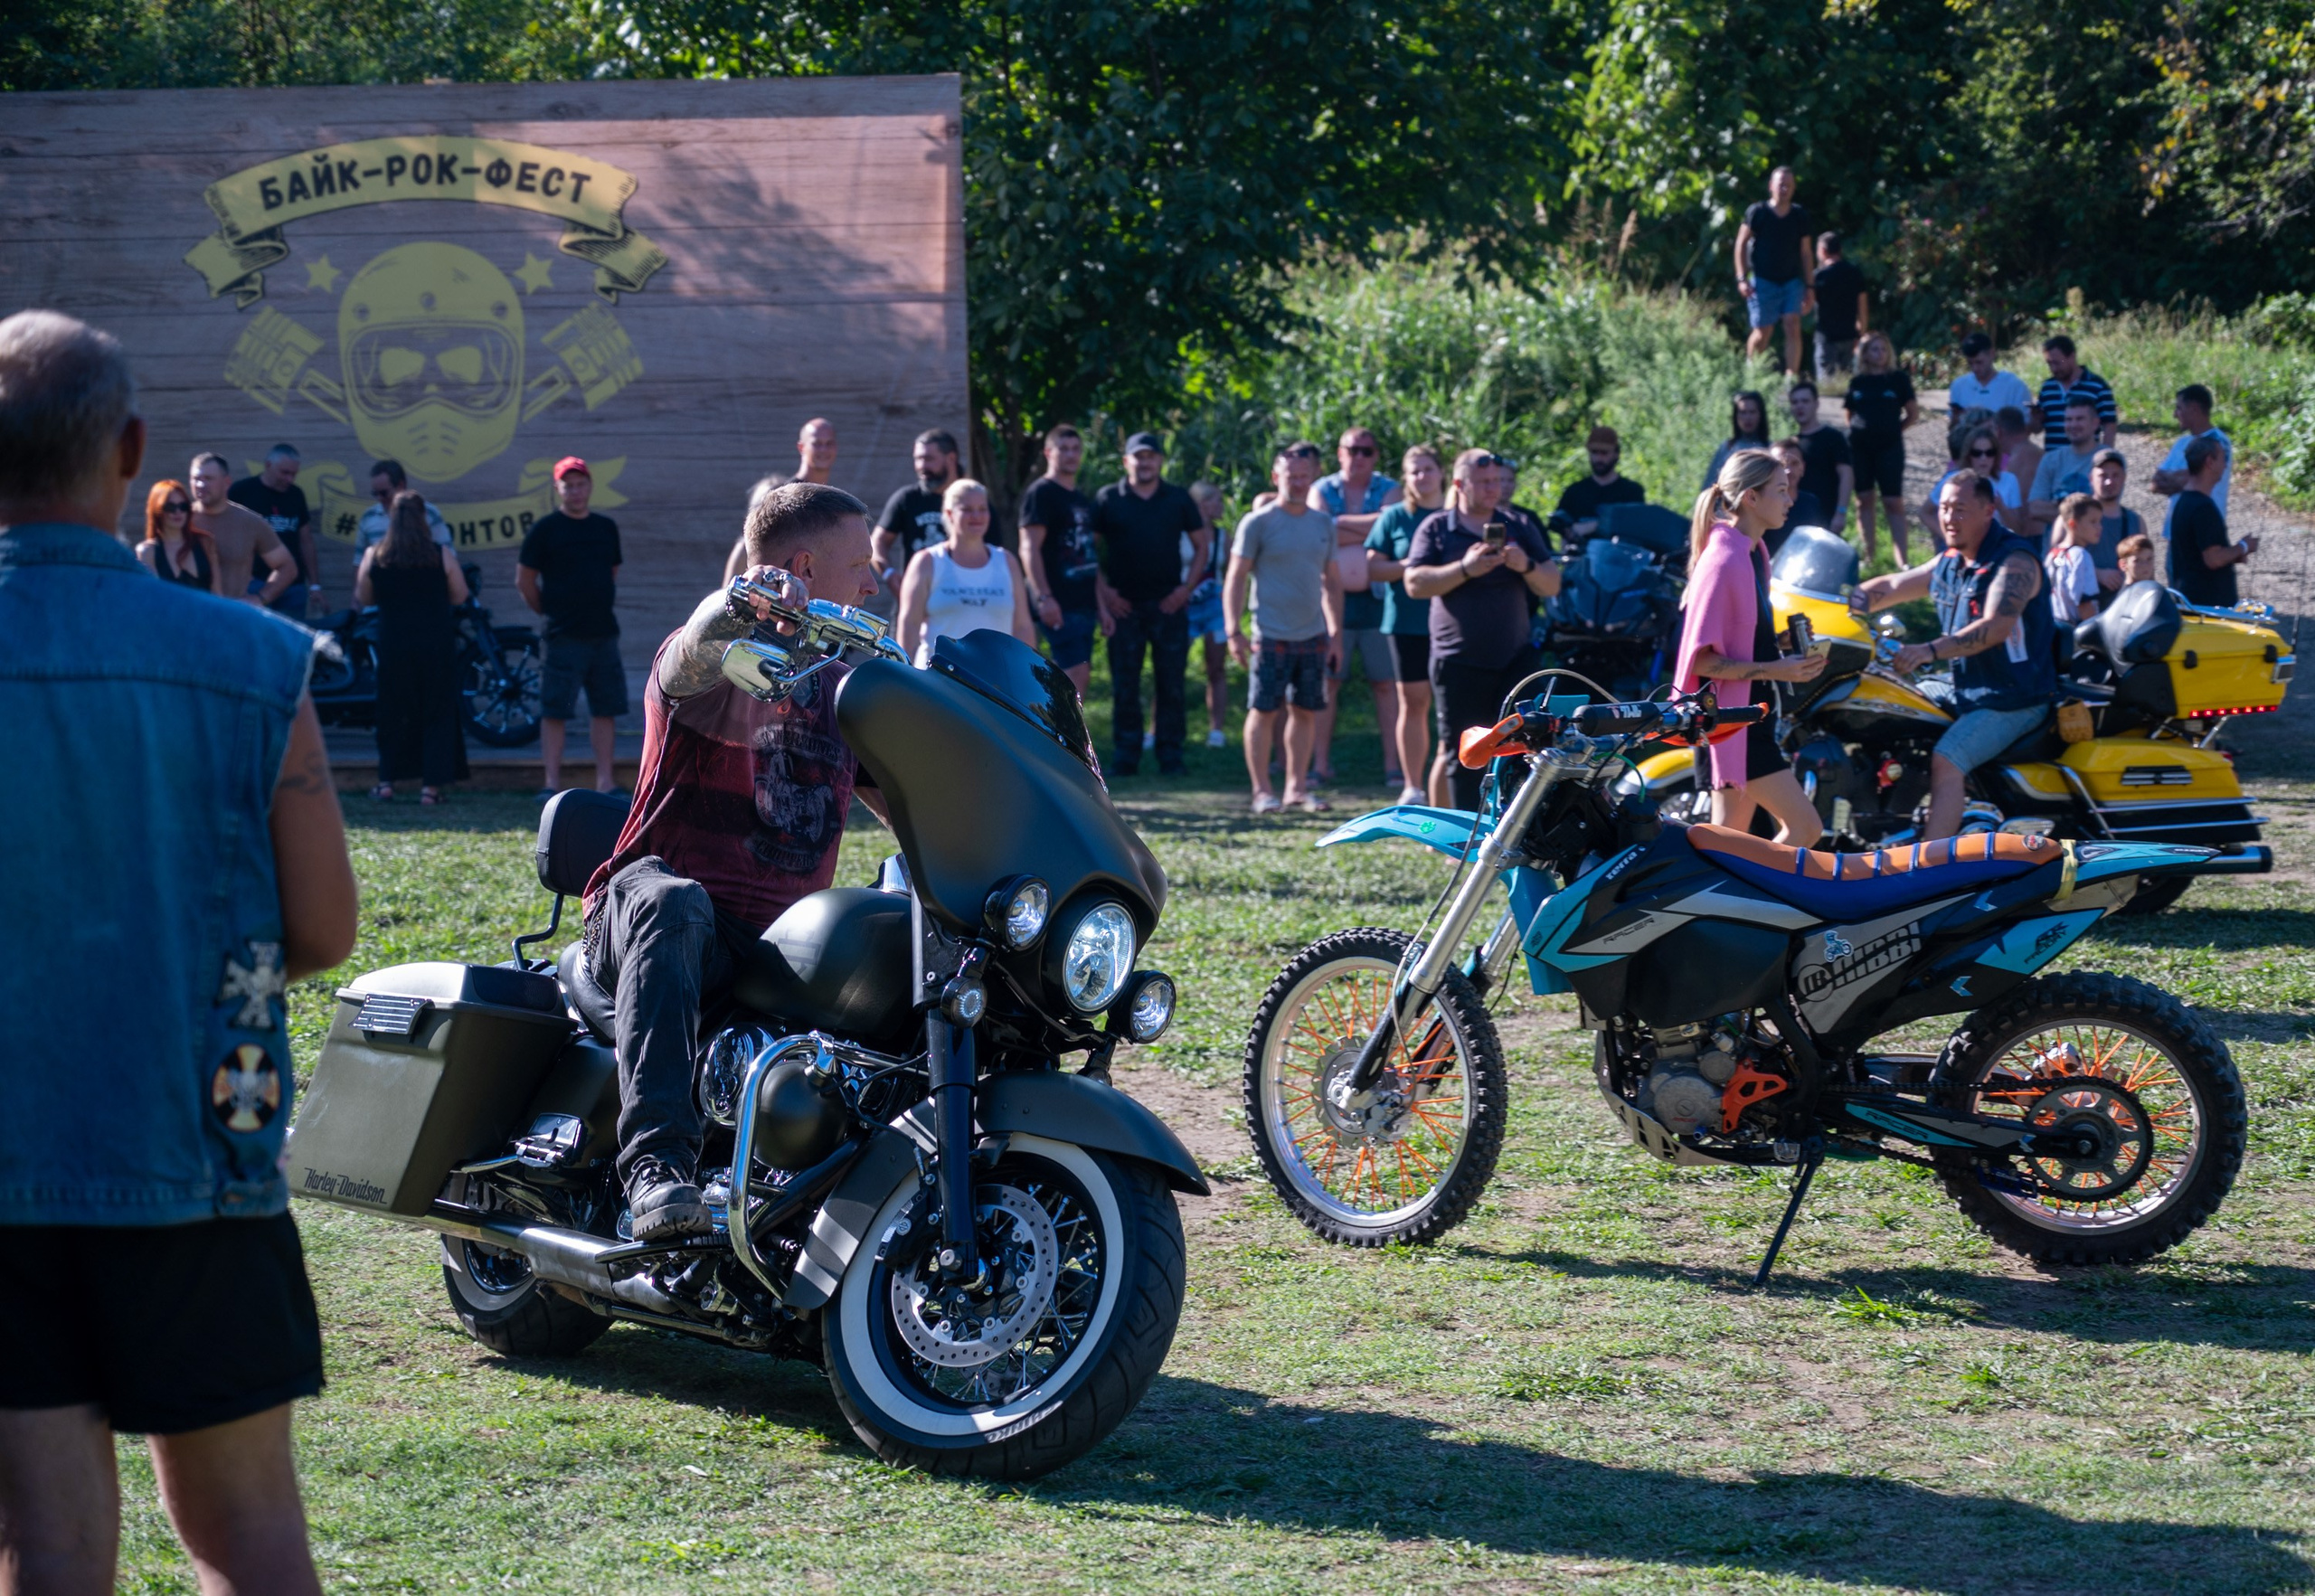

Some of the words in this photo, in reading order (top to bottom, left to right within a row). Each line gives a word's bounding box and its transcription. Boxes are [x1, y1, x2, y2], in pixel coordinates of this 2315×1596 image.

[259, 154, 591, 212] БАЙК-РОК-ФЕСТ
[1602, 917, 1655, 945] RACER
[1865, 1110, 1929, 1139] RACER
[304, 1167, 388, 1204] Harley-Davidson
